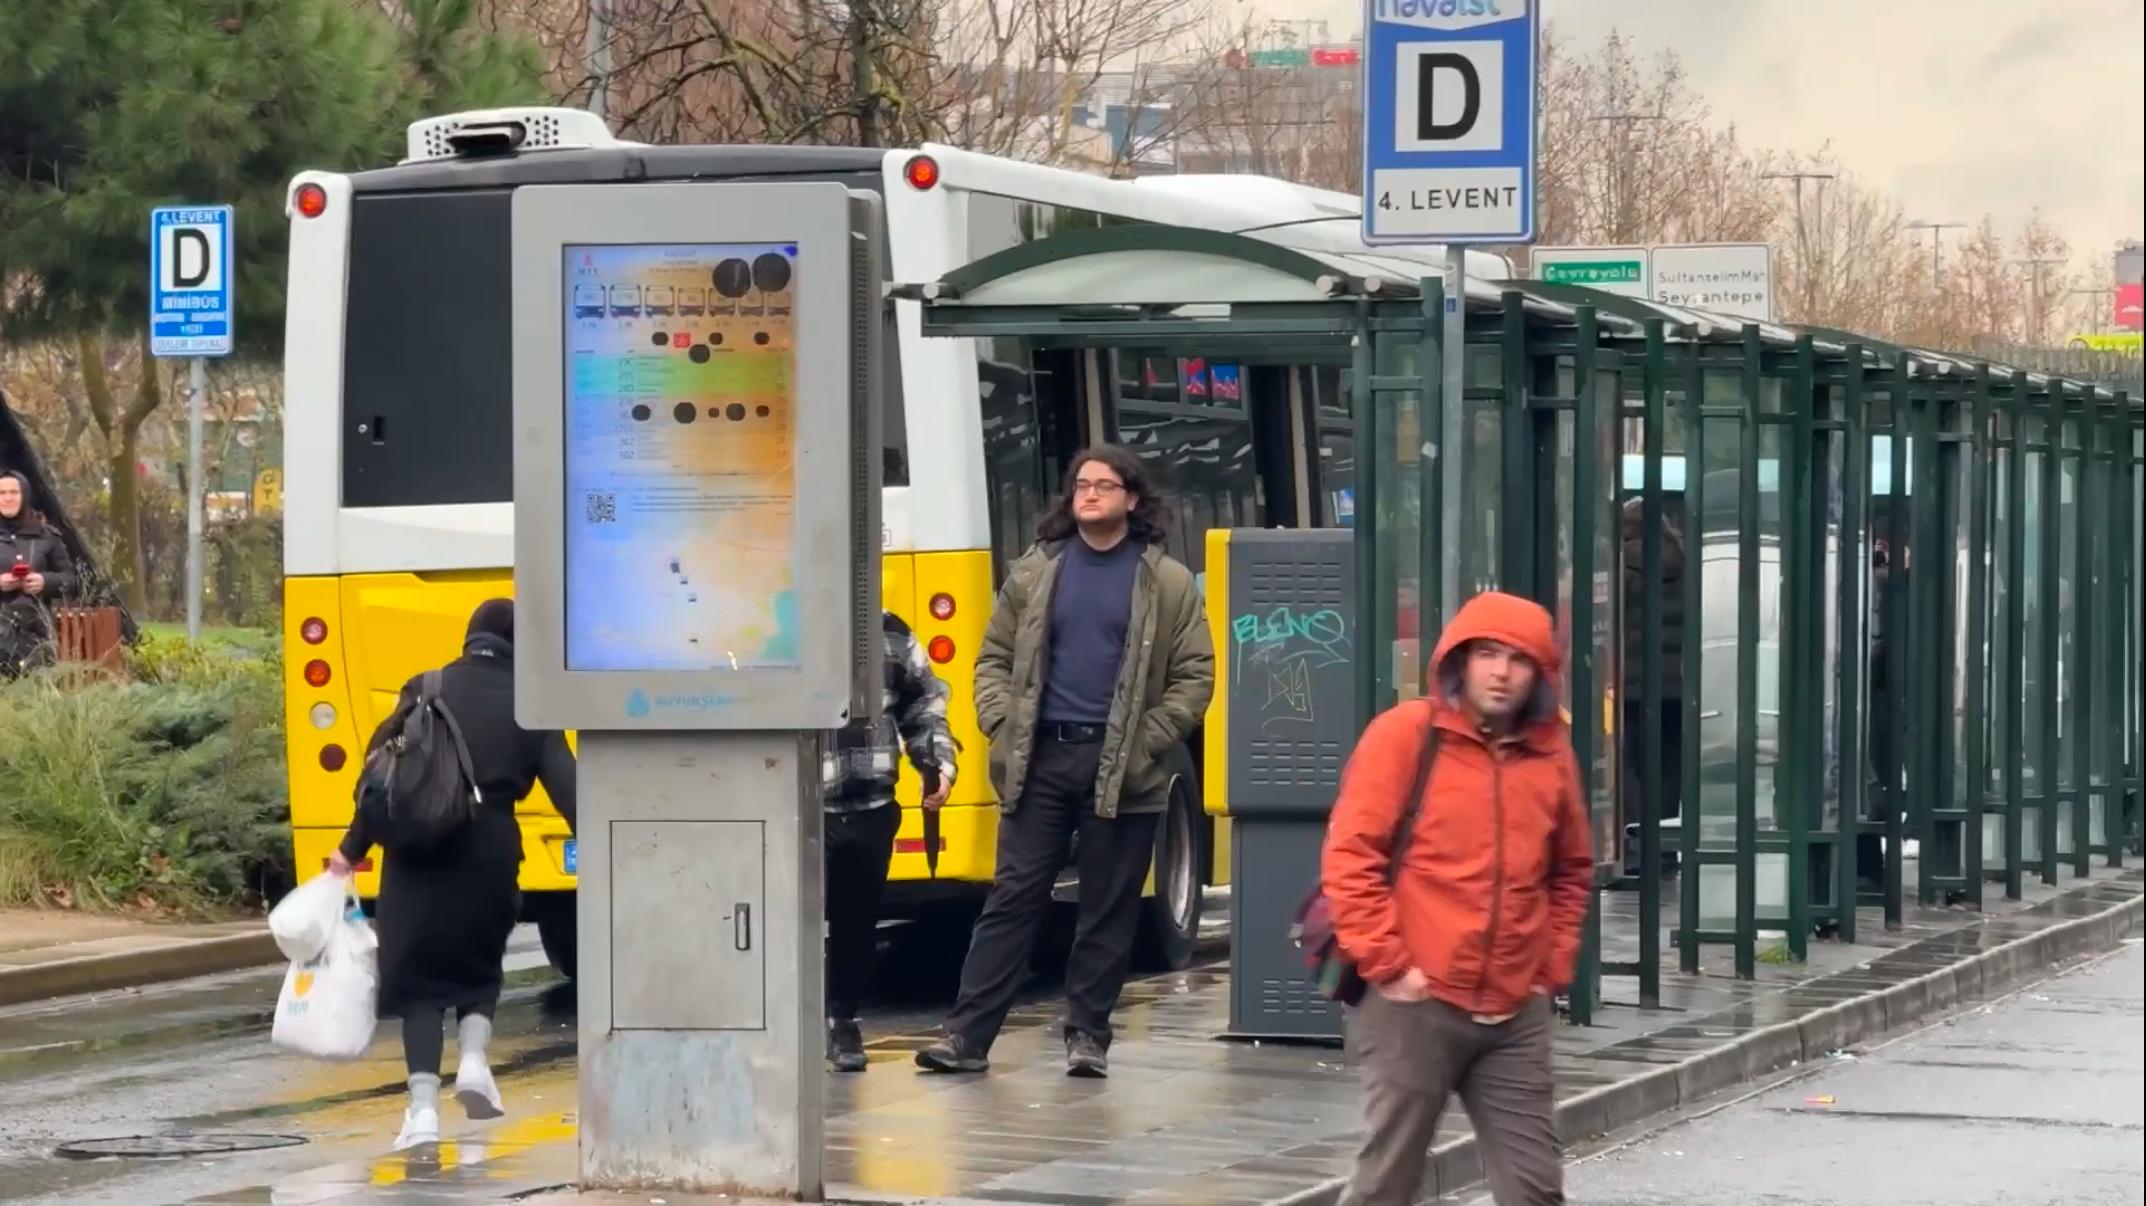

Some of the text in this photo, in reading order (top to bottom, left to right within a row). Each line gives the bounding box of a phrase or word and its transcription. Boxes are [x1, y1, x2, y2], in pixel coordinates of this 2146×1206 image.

[1418, 53, 1481, 141] D
[1378, 186, 1517, 211] 4. LEVENT
[172, 227, 211, 288] D
[1659, 289, 1763, 305] Seyantepe
